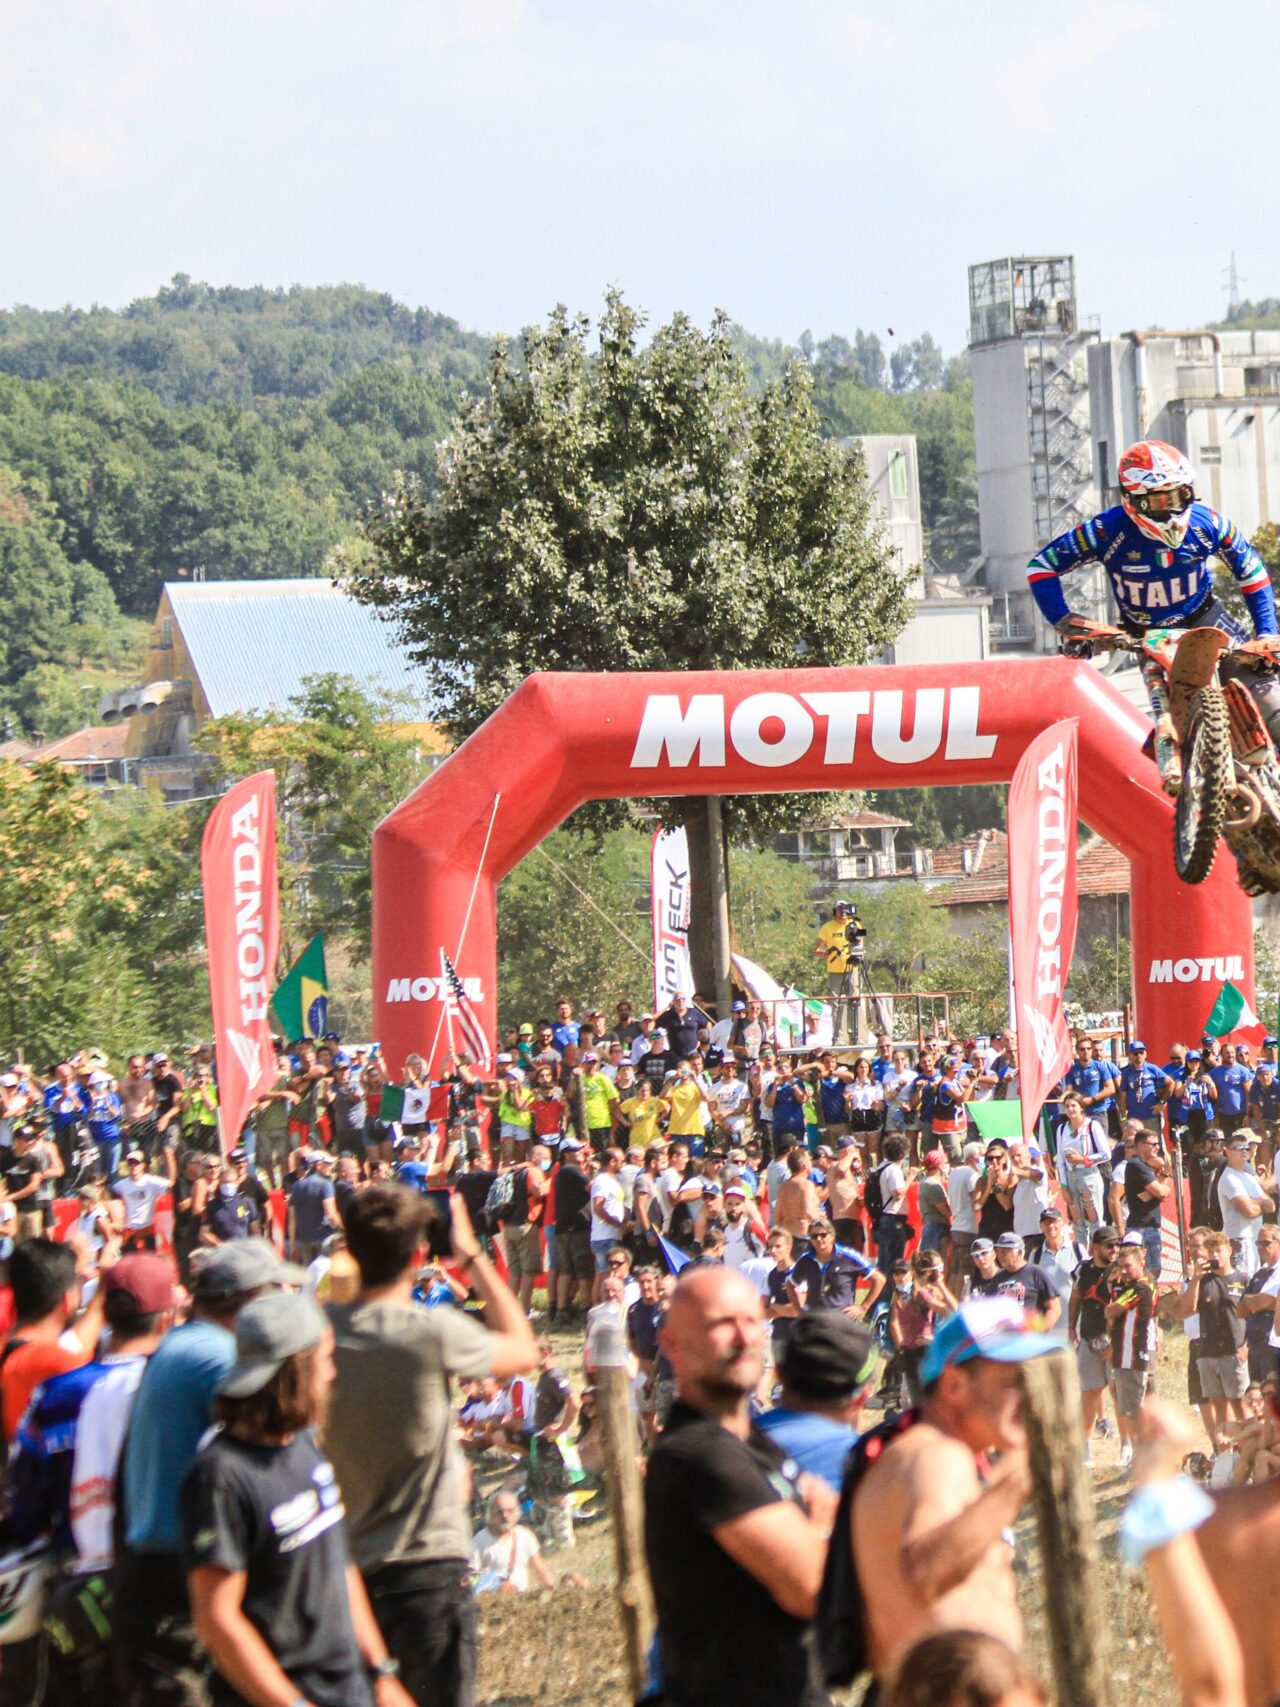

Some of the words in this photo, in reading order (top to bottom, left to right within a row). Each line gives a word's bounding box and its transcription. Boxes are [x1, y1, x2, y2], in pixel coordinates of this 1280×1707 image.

[1112, 570, 1203, 608] ITALI
[629, 686, 999, 768] MOTUL
[231, 793, 269, 1027] HONDA
[1037, 742, 1066, 1000] HONDA
[1149, 956, 1245, 983] MOTUL
